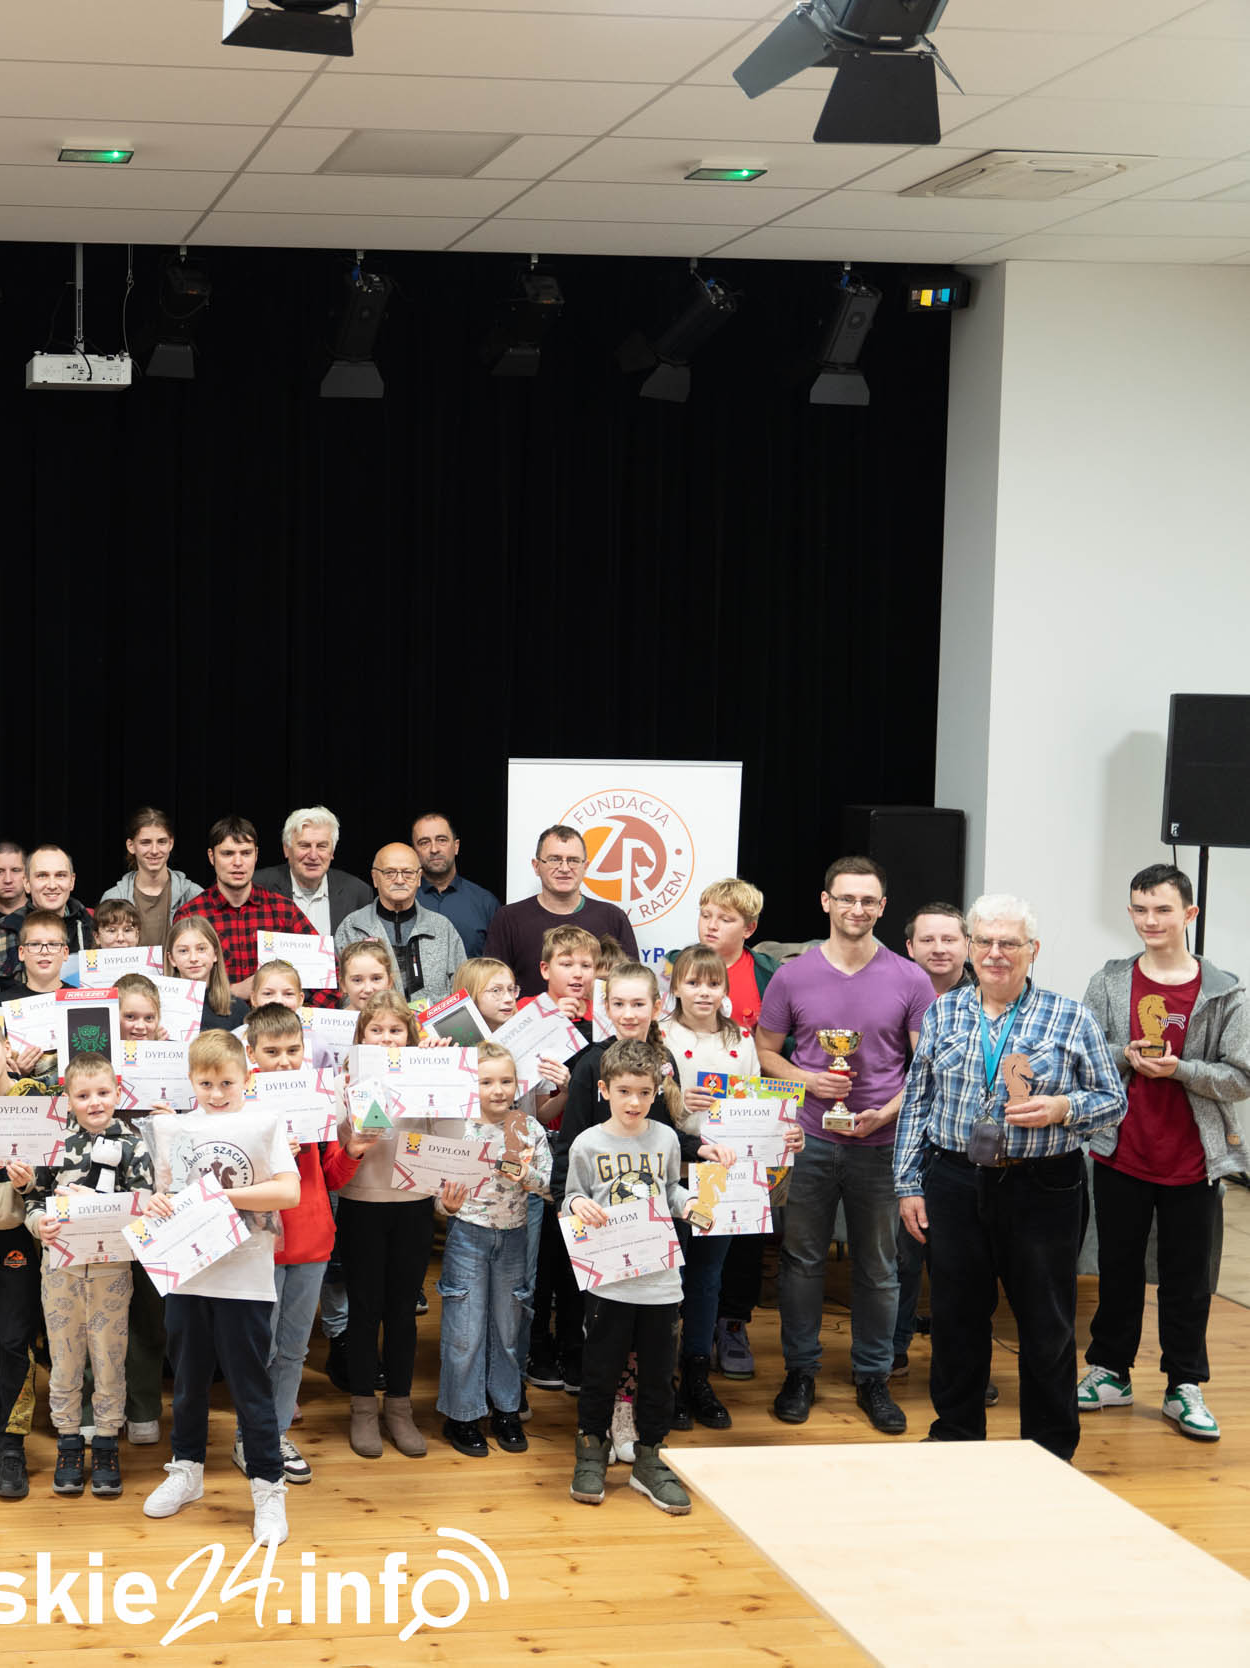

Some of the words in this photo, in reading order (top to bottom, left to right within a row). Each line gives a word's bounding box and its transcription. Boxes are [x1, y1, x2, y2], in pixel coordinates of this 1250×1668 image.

[573, 795, 669, 827] FUNDACJA
[640, 871, 686, 918] RAZEM
[104, 956, 139, 965] DYPLOM
[409, 1057, 450, 1065] DYPLOM
[265, 1081, 307, 1091] DYPLOM
[730, 1109, 770, 1117] DYPLOM
[428, 1144, 470, 1156] DYPLOM
[213, 1145, 249, 1171] SZACHY
[78, 1204, 121, 1214] DYPLOM
